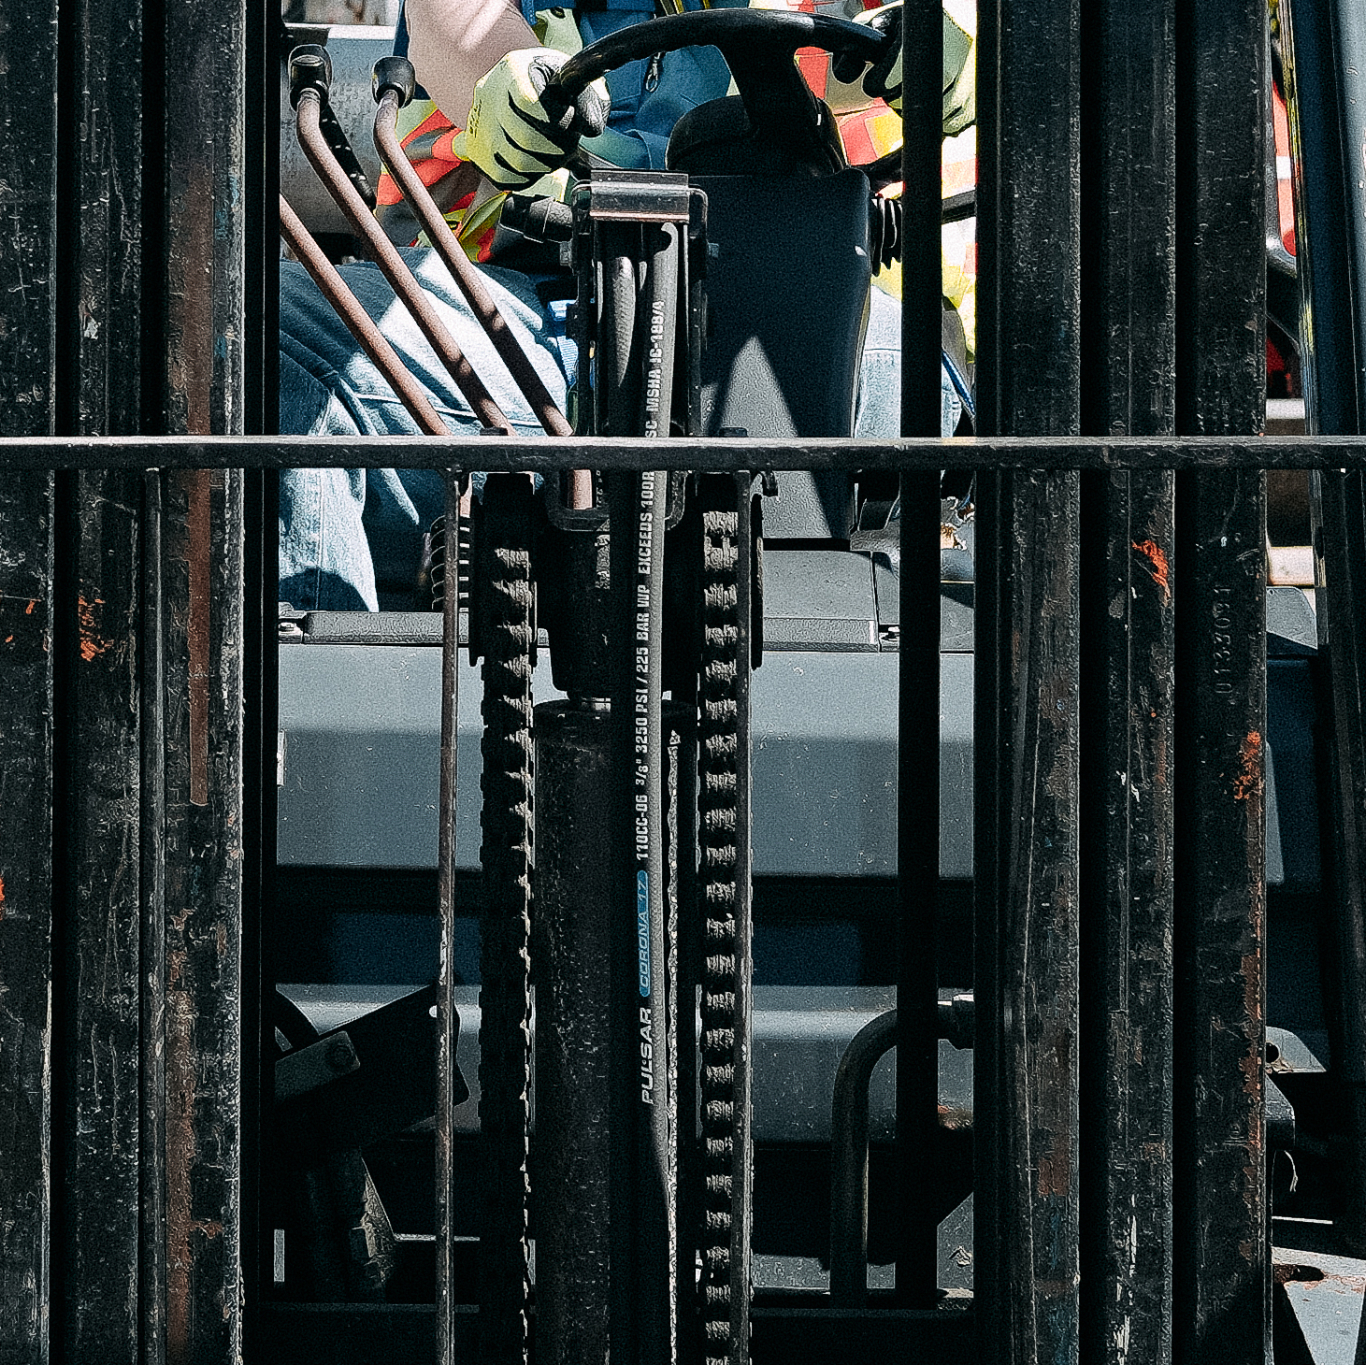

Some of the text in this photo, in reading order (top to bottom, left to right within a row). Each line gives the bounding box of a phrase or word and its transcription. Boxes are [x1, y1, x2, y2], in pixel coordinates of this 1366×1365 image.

[646, 369, 662, 412] MSHA
[638, 512, 653, 575] EXCEEDS
[637, 584, 650, 608] WP
[636, 612, 650, 641] BAR
[635, 647, 649, 673] 225
[635, 676, 649, 684] /
[635, 688, 649, 713] PSI
[635, 717, 648, 753] 3250
[637, 879, 648, 901] 17
[638, 910, 649, 988] CORONA
[639, 1007, 654, 1105] PULSAR
